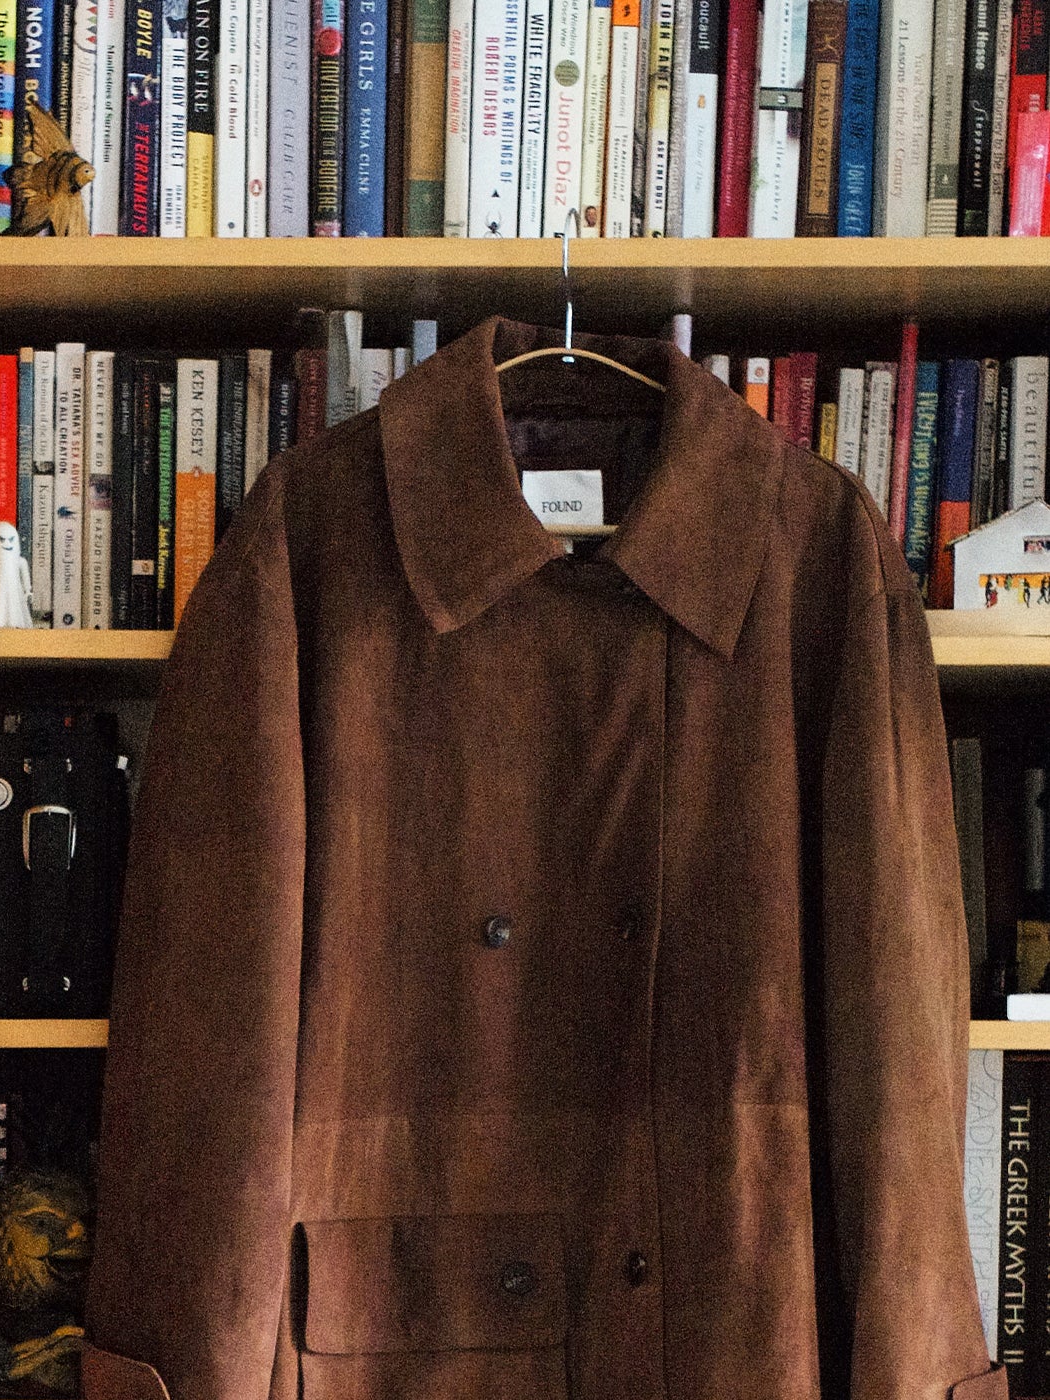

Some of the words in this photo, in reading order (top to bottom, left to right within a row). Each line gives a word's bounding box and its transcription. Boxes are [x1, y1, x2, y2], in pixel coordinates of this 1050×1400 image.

[559, 3, 568, 25] Oscar
[659, 3, 672, 39] JOHN
[697, 1, 710, 50] oucault
[898, 19, 909, 31] 21
[24, 7, 43, 68] NOAH
[136, 8, 153, 60] BOYLE
[195, 36, 210, 61] ON
[227, 15, 239, 54] Capote
[451, 29, 461, 71] CREATIVE
[528, 14, 544, 60] WHITE
[558, 28, 568, 47] Wao
[568, 12, 579, 56] Wondrous
[975, 32, 990, 71] Hesse
[999, 25, 1010, 58] Hesse
[104, 44, 117, 98] Manifestoes
[171, 48, 186, 67] THE
[228, 64, 241, 74] In
[357, 22, 376, 91] GIRLS
[484, 37, 500, 82] ROBERT
[503, 55, 517, 92] POEMS
[657, 47, 670, 91] FANTE
[897, 36, 909, 83] Lessons
[913, 54, 925, 87] Yuval
[171, 76, 186, 108] BODY
[193, 70, 209, 113] FIRE
[228, 79, 239, 104] Cold
[319, 61, 340, 132] INVITATION
[527, 66, 543, 135] FRAGILITY
[896, 86, 909, 104] for
[997, 73, 1007, 94] The
[103, 100, 115, 111] of
[449, 76, 460, 134] IMAGINATION
[482, 90, 499, 137] DESNOS
[557, 91, 574, 151] Junot
[817, 78, 833, 128] DEAD
[895, 107, 908, 126] the
[912, 91, 924, 121] Noah
[993, 96, 1006, 135] Journey
[101, 113, 115, 163] Surrealism
[170, 114, 186, 169] PROJECT
[227, 108, 239, 140] Blood
[358, 107, 371, 148] EMMA
[501, 111, 515, 165] WRITINGS
[656, 141, 665, 157] ASK
[775, 141, 785, 169] allen
[910, 126, 923, 165] Harari
[969, 100, 989, 188] Steppenwolf
[993, 138, 1004, 149] to
[993, 153, 1004, 169] the
[132, 134, 150, 234] TERRANAUTS
[191, 158, 201, 210] CAHALAN
[317, 159, 339, 213] BONFIRE
[357, 153, 370, 196] CLINE
[500, 172, 514, 184] OF
[554, 160, 572, 207] Díaz
[655, 164, 664, 180] THE
[812, 138, 830, 198] SOULS
[846, 162, 867, 196] JOHN
[890, 148, 906, 199] Century
[992, 173, 1003, 196] East
[164, 187, 174, 226] BRUMBERG
[175, 184, 183, 201] JOAN
[281, 170, 295, 215] CARR
[654, 185, 663, 210] DUST
[771, 174, 783, 221] ginsberg
[38, 360, 49, 375] The
[71, 367, 82, 383] DR.
[95, 361, 105, 399] NEVER
[191, 369, 205, 401] KEN
[38, 377, 49, 411] Remains
[59, 391, 69, 403] TO
[71, 387, 82, 436] TATIANA'S
[95, 404, 105, 422] LET
[280, 384, 289, 416] DAVID
[1000, 386, 1009, 430] JEAN-PAUL
[58, 406, 68, 424] ALL
[190, 407, 205, 457] KESEY
[58, 427, 68, 474] CREATION
[70, 440, 81, 460] SEX
[94, 432, 104, 446] ME
[1021, 371, 1046, 503] beautiful
[94, 452, 104, 468] GO
[69, 463, 80, 497] ADVICE
[36, 484, 49, 522] Kazuo
[541, 499, 583, 514] FOUND
[35, 524, 48, 568] Ishiguro
[64, 528, 75, 557] Olivia
[93, 518, 103, 556] KAZUO
[157, 525, 170, 550] Jack
[62, 559, 74, 594] Judson
[92, 561, 102, 615] ISHIGURO
[968, 1082, 997, 1174] ZADIE
[1008, 1099, 1031, 1152] THE
[1006, 1157, 1030, 1237] GREEK
[1003, 1241, 1027, 1336] MYTHS
[1002, 1349, 1025, 1365] II
